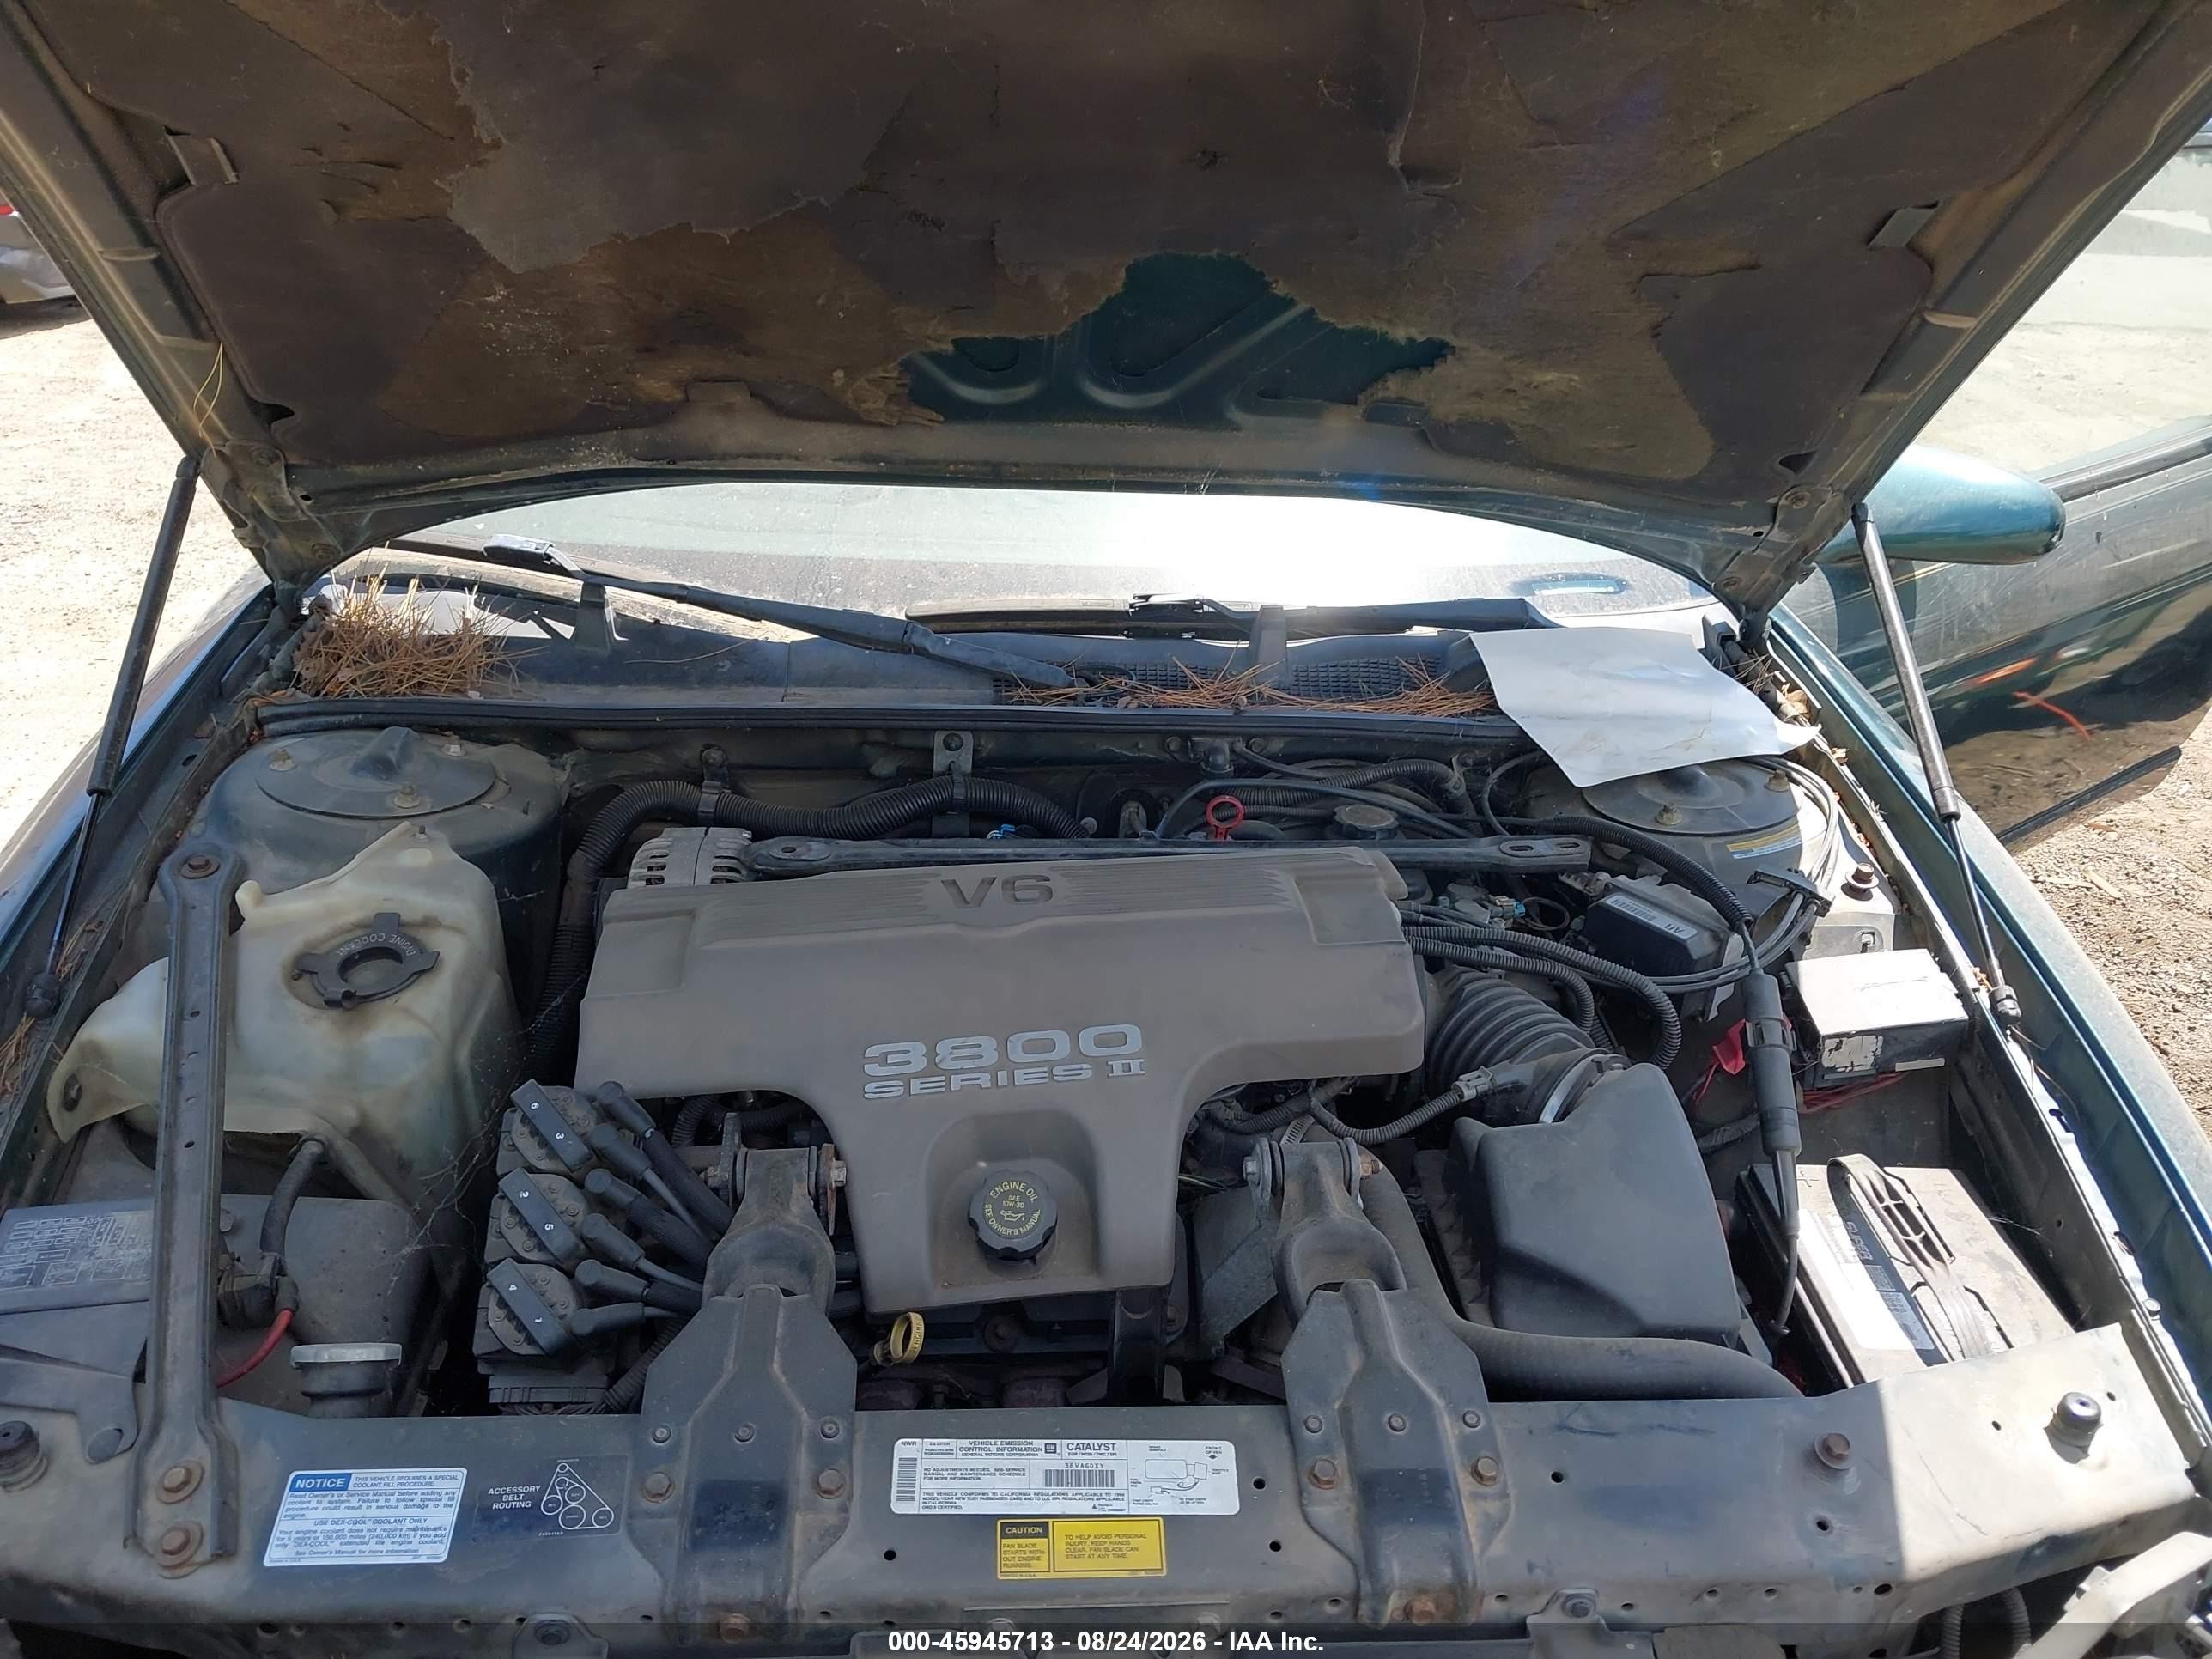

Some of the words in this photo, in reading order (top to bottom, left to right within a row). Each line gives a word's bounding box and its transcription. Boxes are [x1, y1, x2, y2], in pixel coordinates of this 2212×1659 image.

[941, 875, 1053, 908] V6
[336, 933, 386, 956] COOLANT
[389, 934, 416, 957] ENGINE
[864, 1024, 1142, 1077] 3800
[864, 1063, 1092, 1099] SERIES
[1107, 1059, 1146, 1077] II
[990, 1181, 1027, 1198] ENGINE
[1025, 1188, 1038, 1203] OIL
[1019, 1209, 1041, 1234] MANUAL
[1066, 1443, 1116, 1451] CATALYST
[295, 1478, 345, 1488] NOTICE
[488, 1486, 541, 1495] ACCESSORY
[492, 1501, 532, 1510] ROUTING
